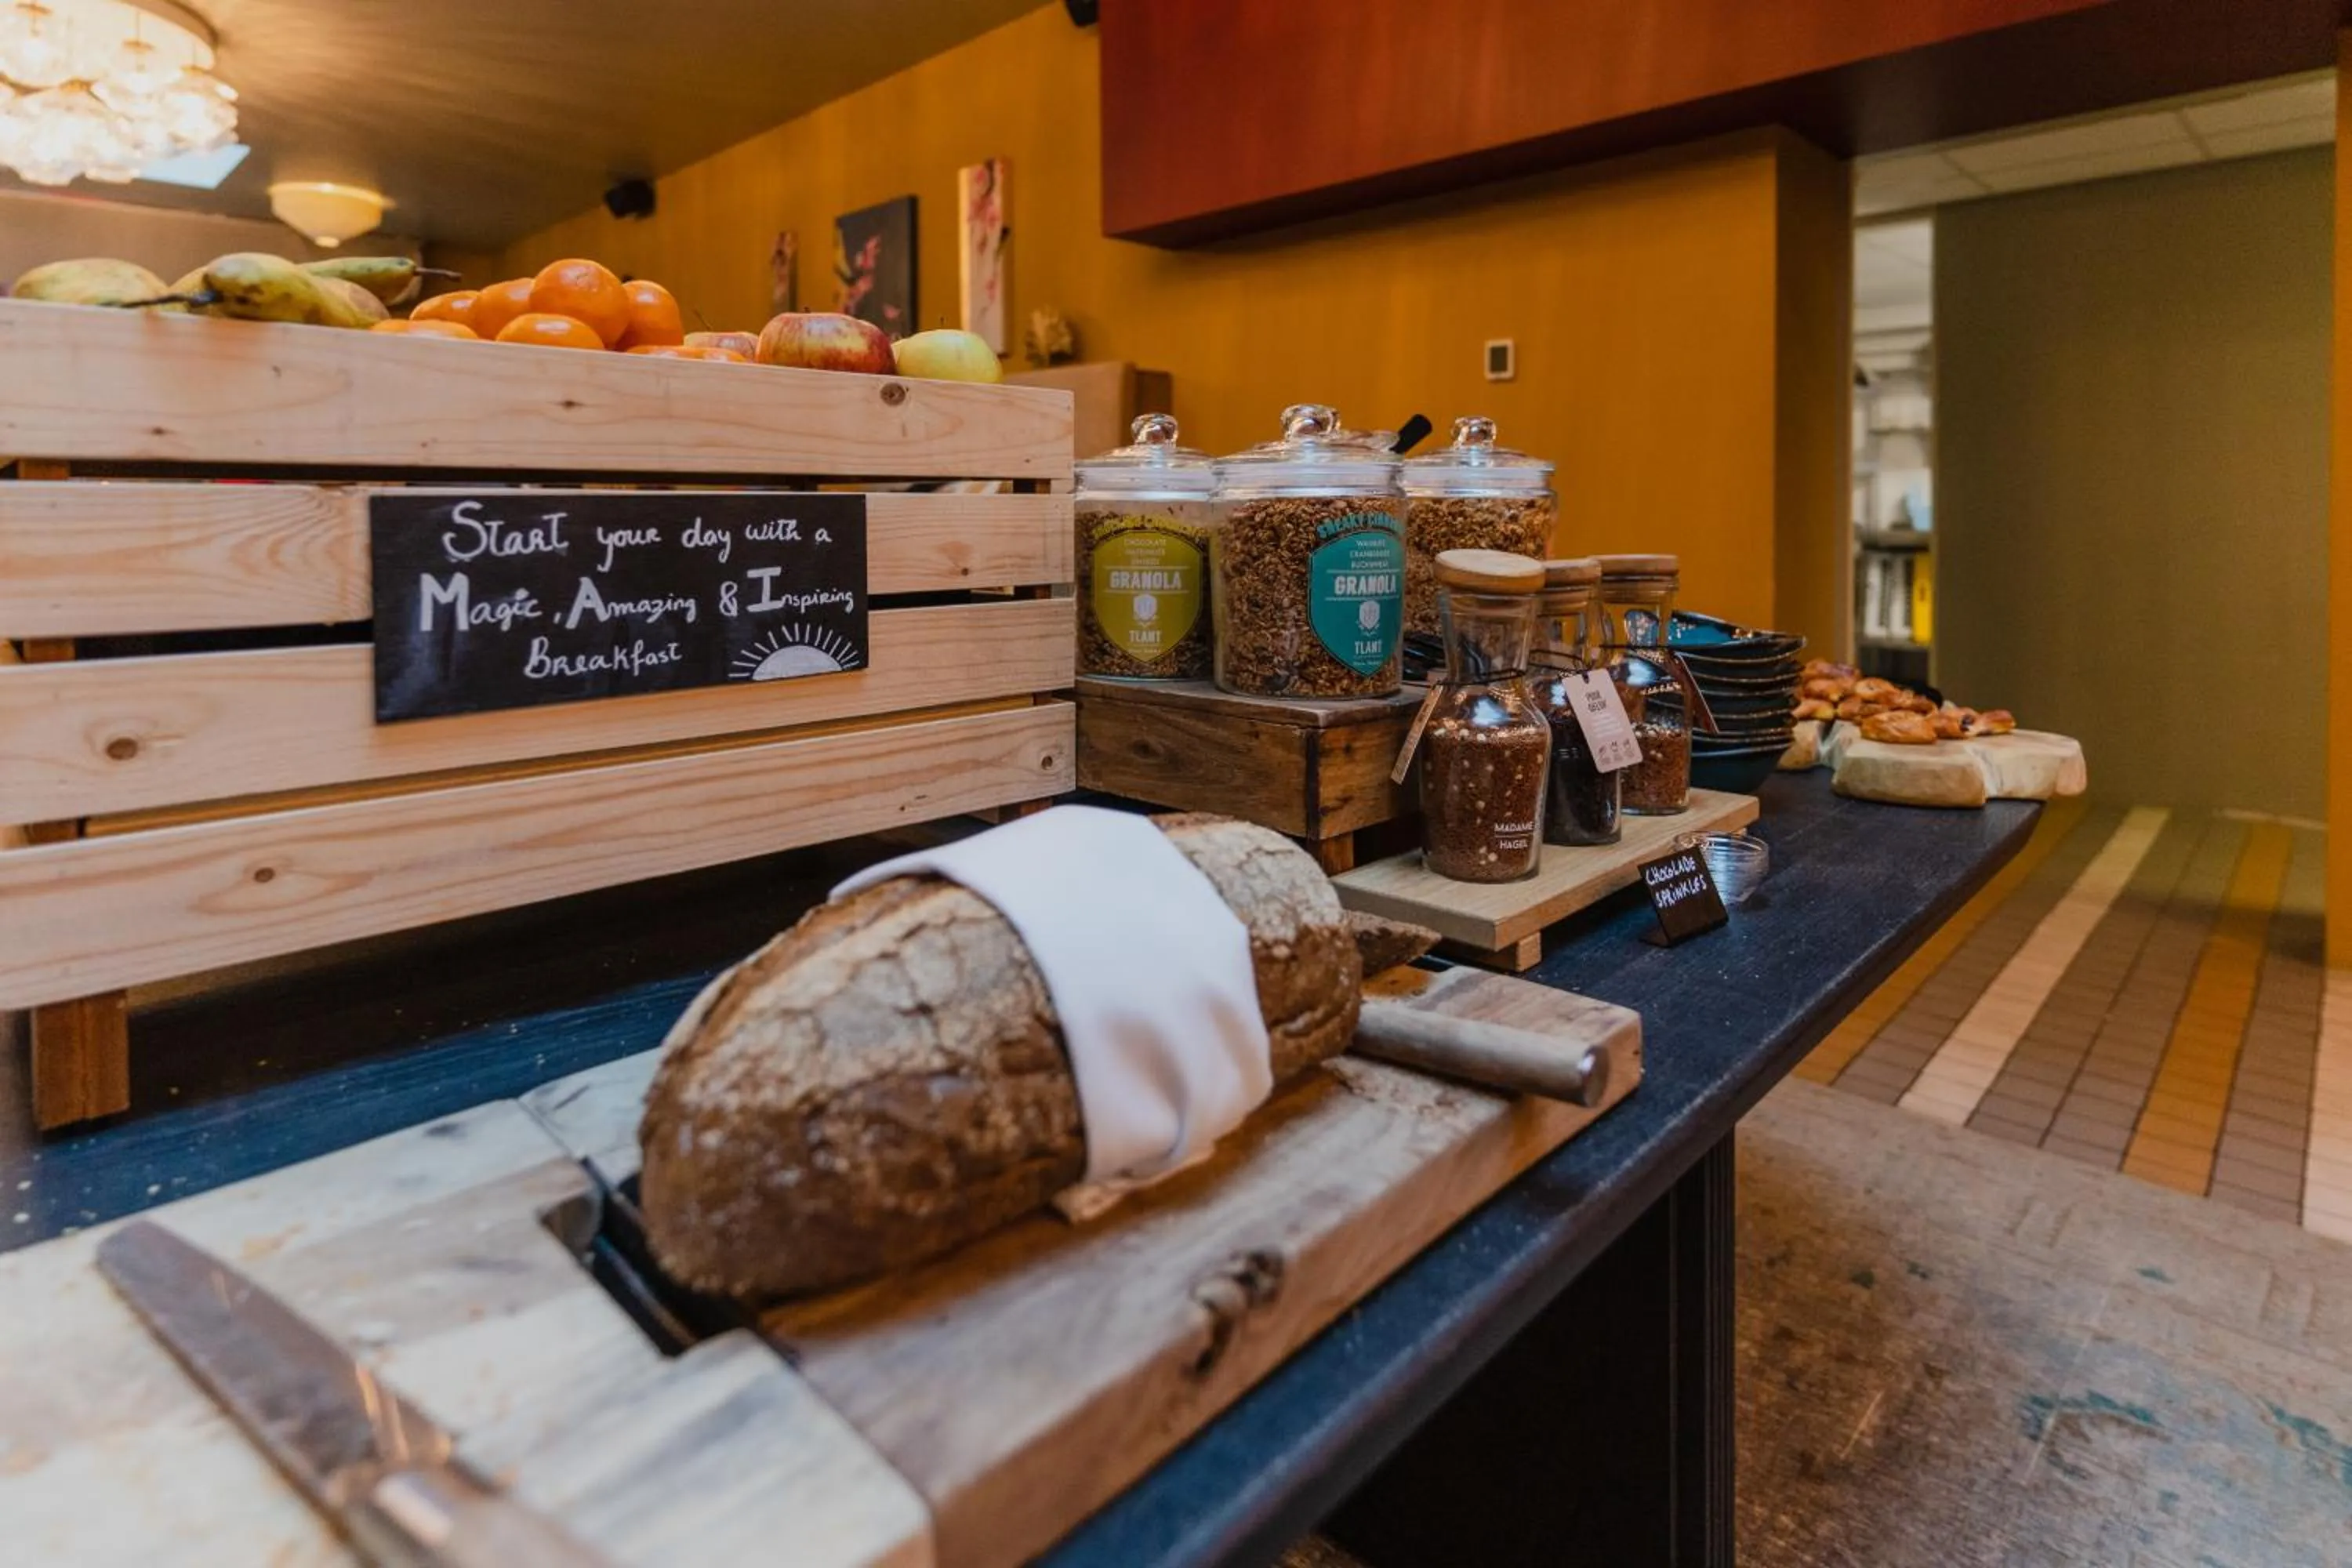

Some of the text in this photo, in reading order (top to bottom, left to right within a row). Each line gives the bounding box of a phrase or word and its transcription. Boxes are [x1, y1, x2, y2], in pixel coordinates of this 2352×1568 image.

[597, 525, 662, 572] your
[681, 517, 731, 561] day
[746, 518, 802, 541] with
[815, 528, 833, 545] a
[1109, 571, 1181, 590] GRANOLA
[1334, 574, 1396, 596] GRANOLA
[719, 581, 739, 616] &
[746, 566, 854, 615] Inspiring
[1129, 630, 1161, 643] TLANT
[1354, 640, 1382, 655] TLANT
[524, 637, 682, 678] Breakfast
[1494, 821, 1534, 831] MADAME
[1500, 840, 1528, 849] HAGEL
